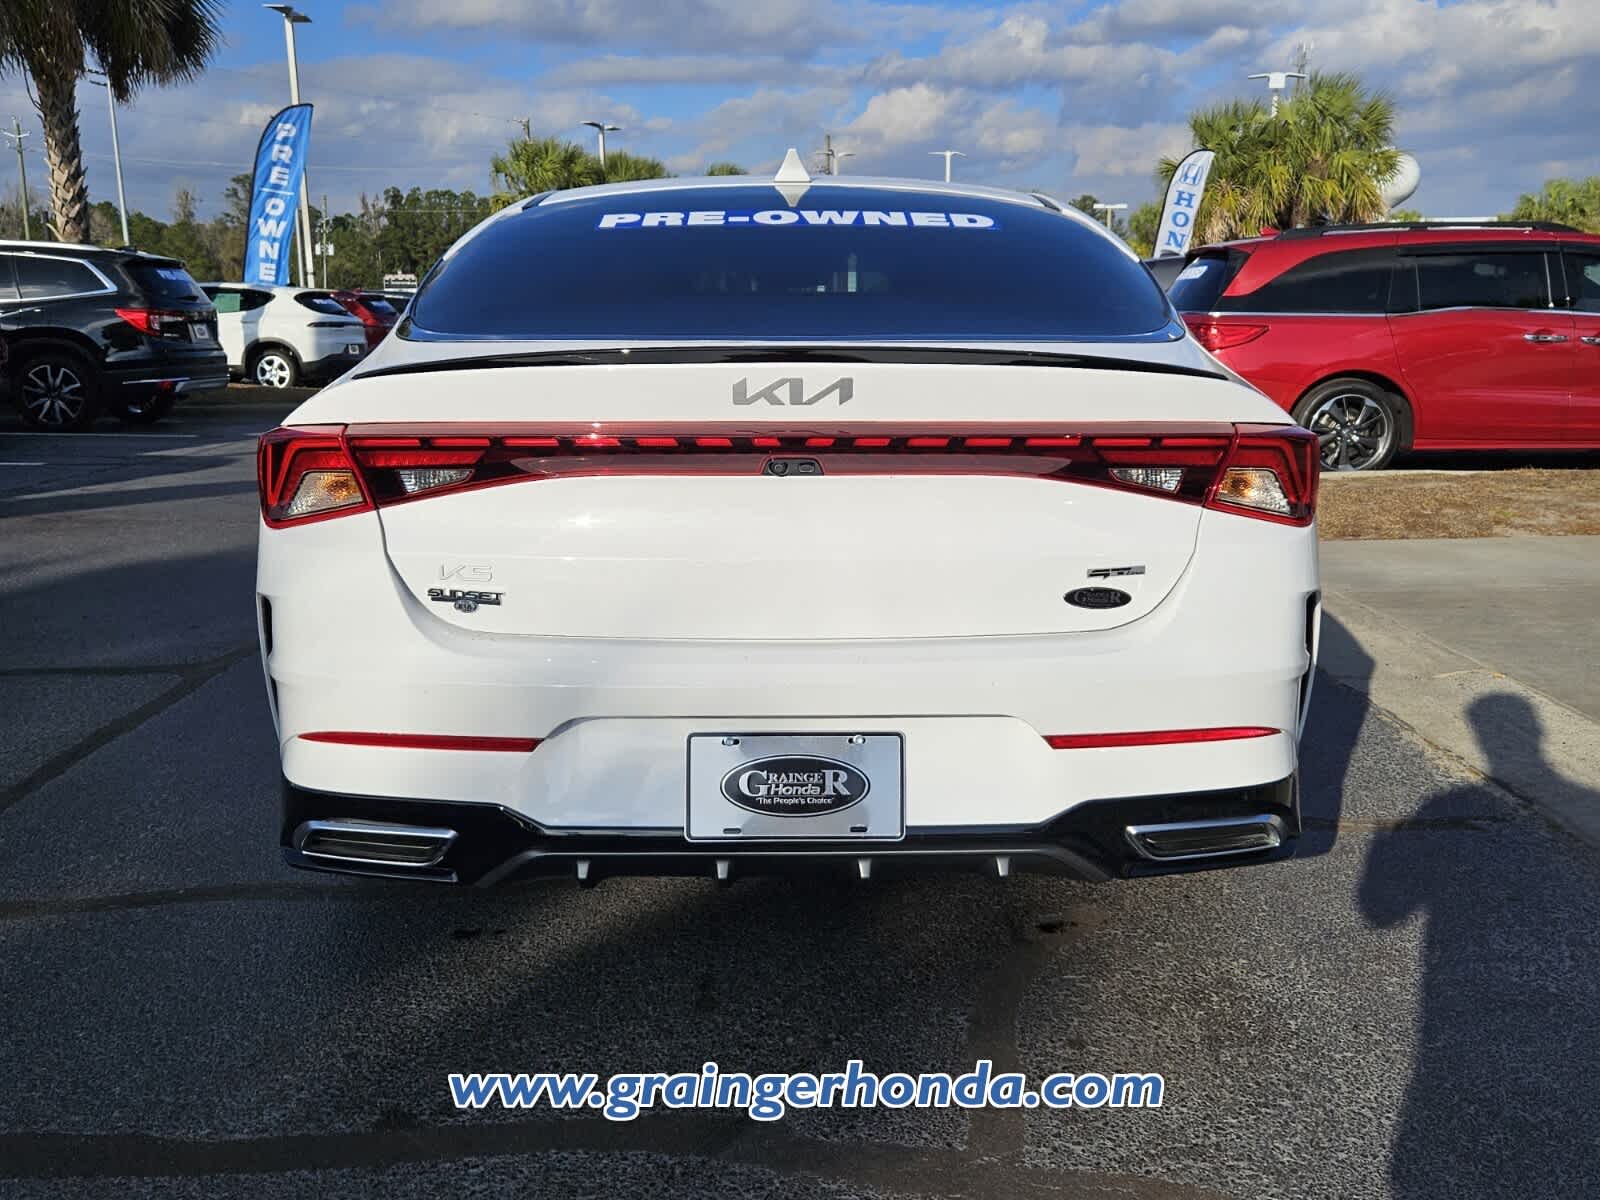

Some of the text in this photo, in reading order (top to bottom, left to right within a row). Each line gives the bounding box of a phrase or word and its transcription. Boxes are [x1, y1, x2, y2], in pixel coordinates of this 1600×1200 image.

[598, 210, 996, 229] PRE-OWNED
[732, 377, 854, 406] KIA
[439, 563, 493, 582] K5
[427, 588, 505, 602] SUNSET
[738, 769, 851, 797] GRAINGER
[770, 783, 821, 795] Honda
[773, 797, 806, 805] People's
